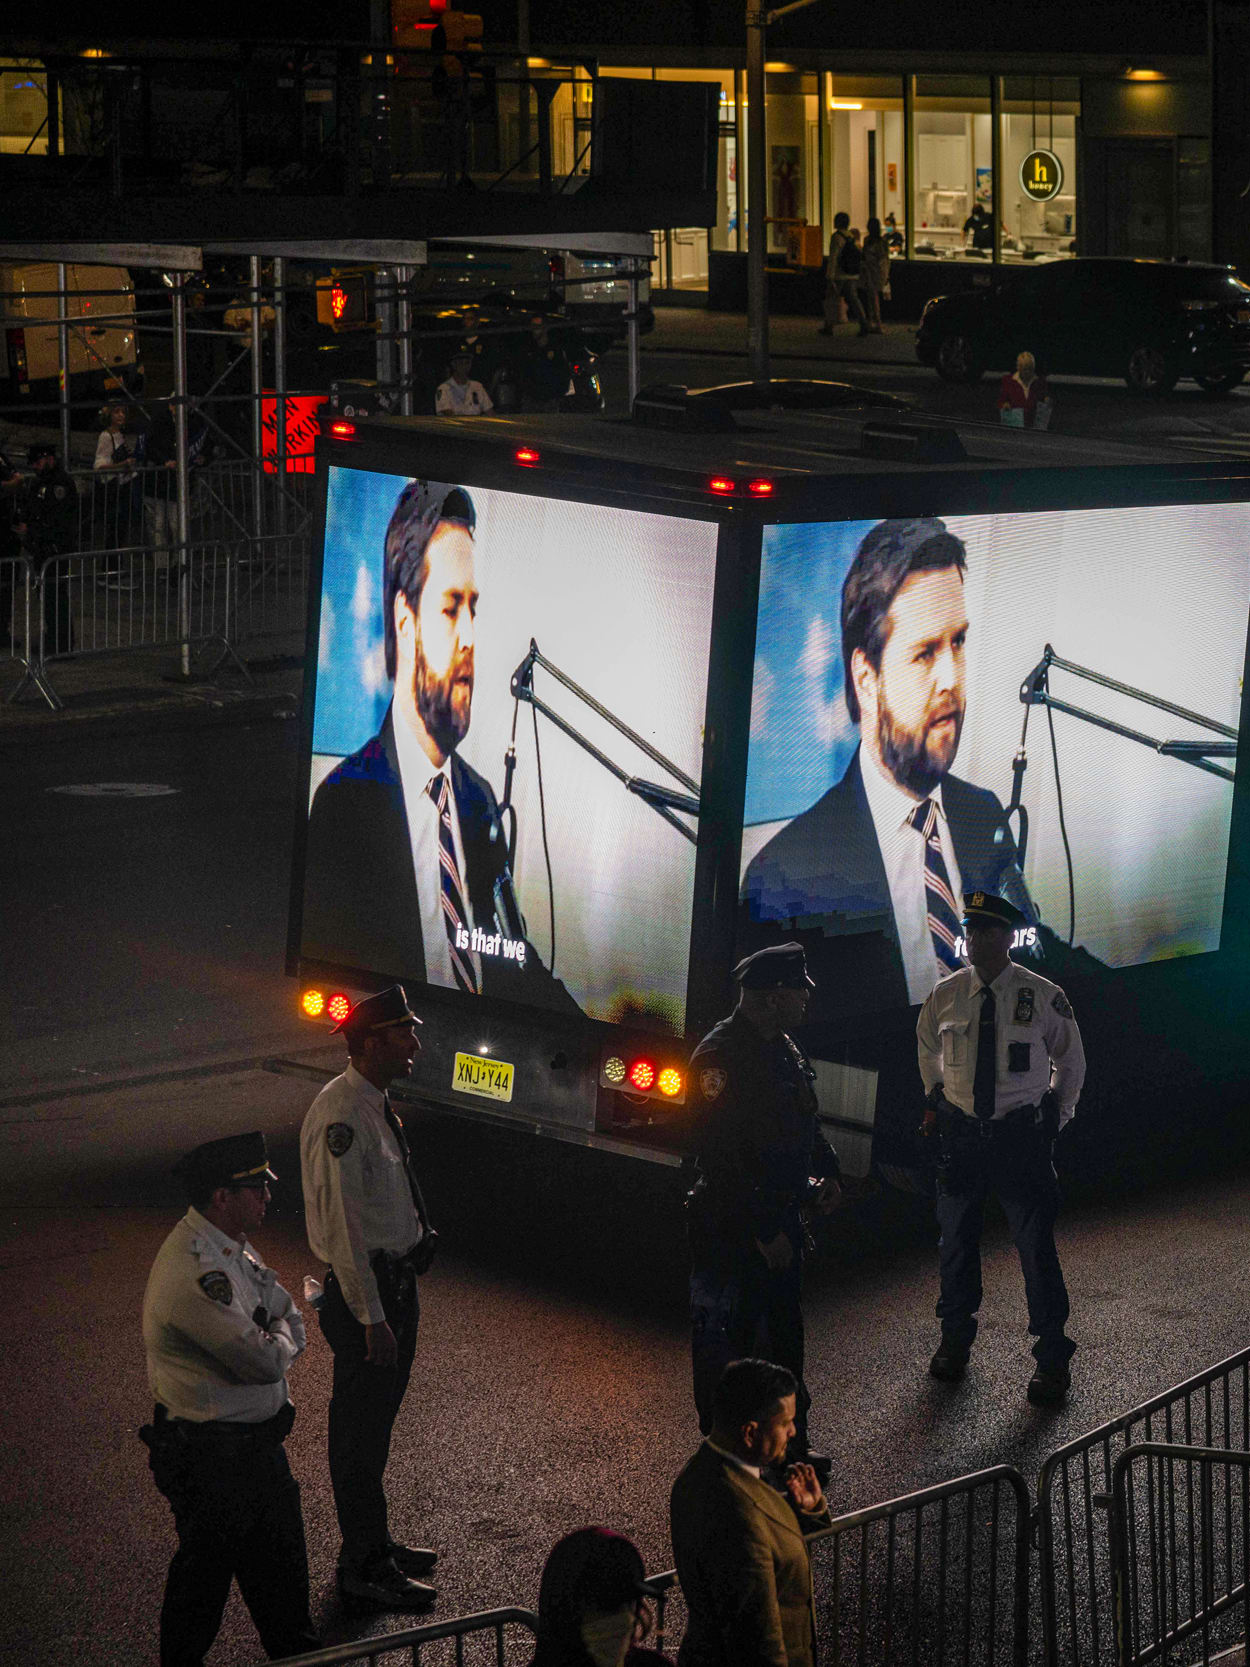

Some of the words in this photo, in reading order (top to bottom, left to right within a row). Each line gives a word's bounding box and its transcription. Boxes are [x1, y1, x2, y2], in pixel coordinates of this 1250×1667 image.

[1034, 157, 1047, 182] h
[456, 921, 469, 949] is
[471, 927, 501, 956] that
[503, 938, 526, 961] we
